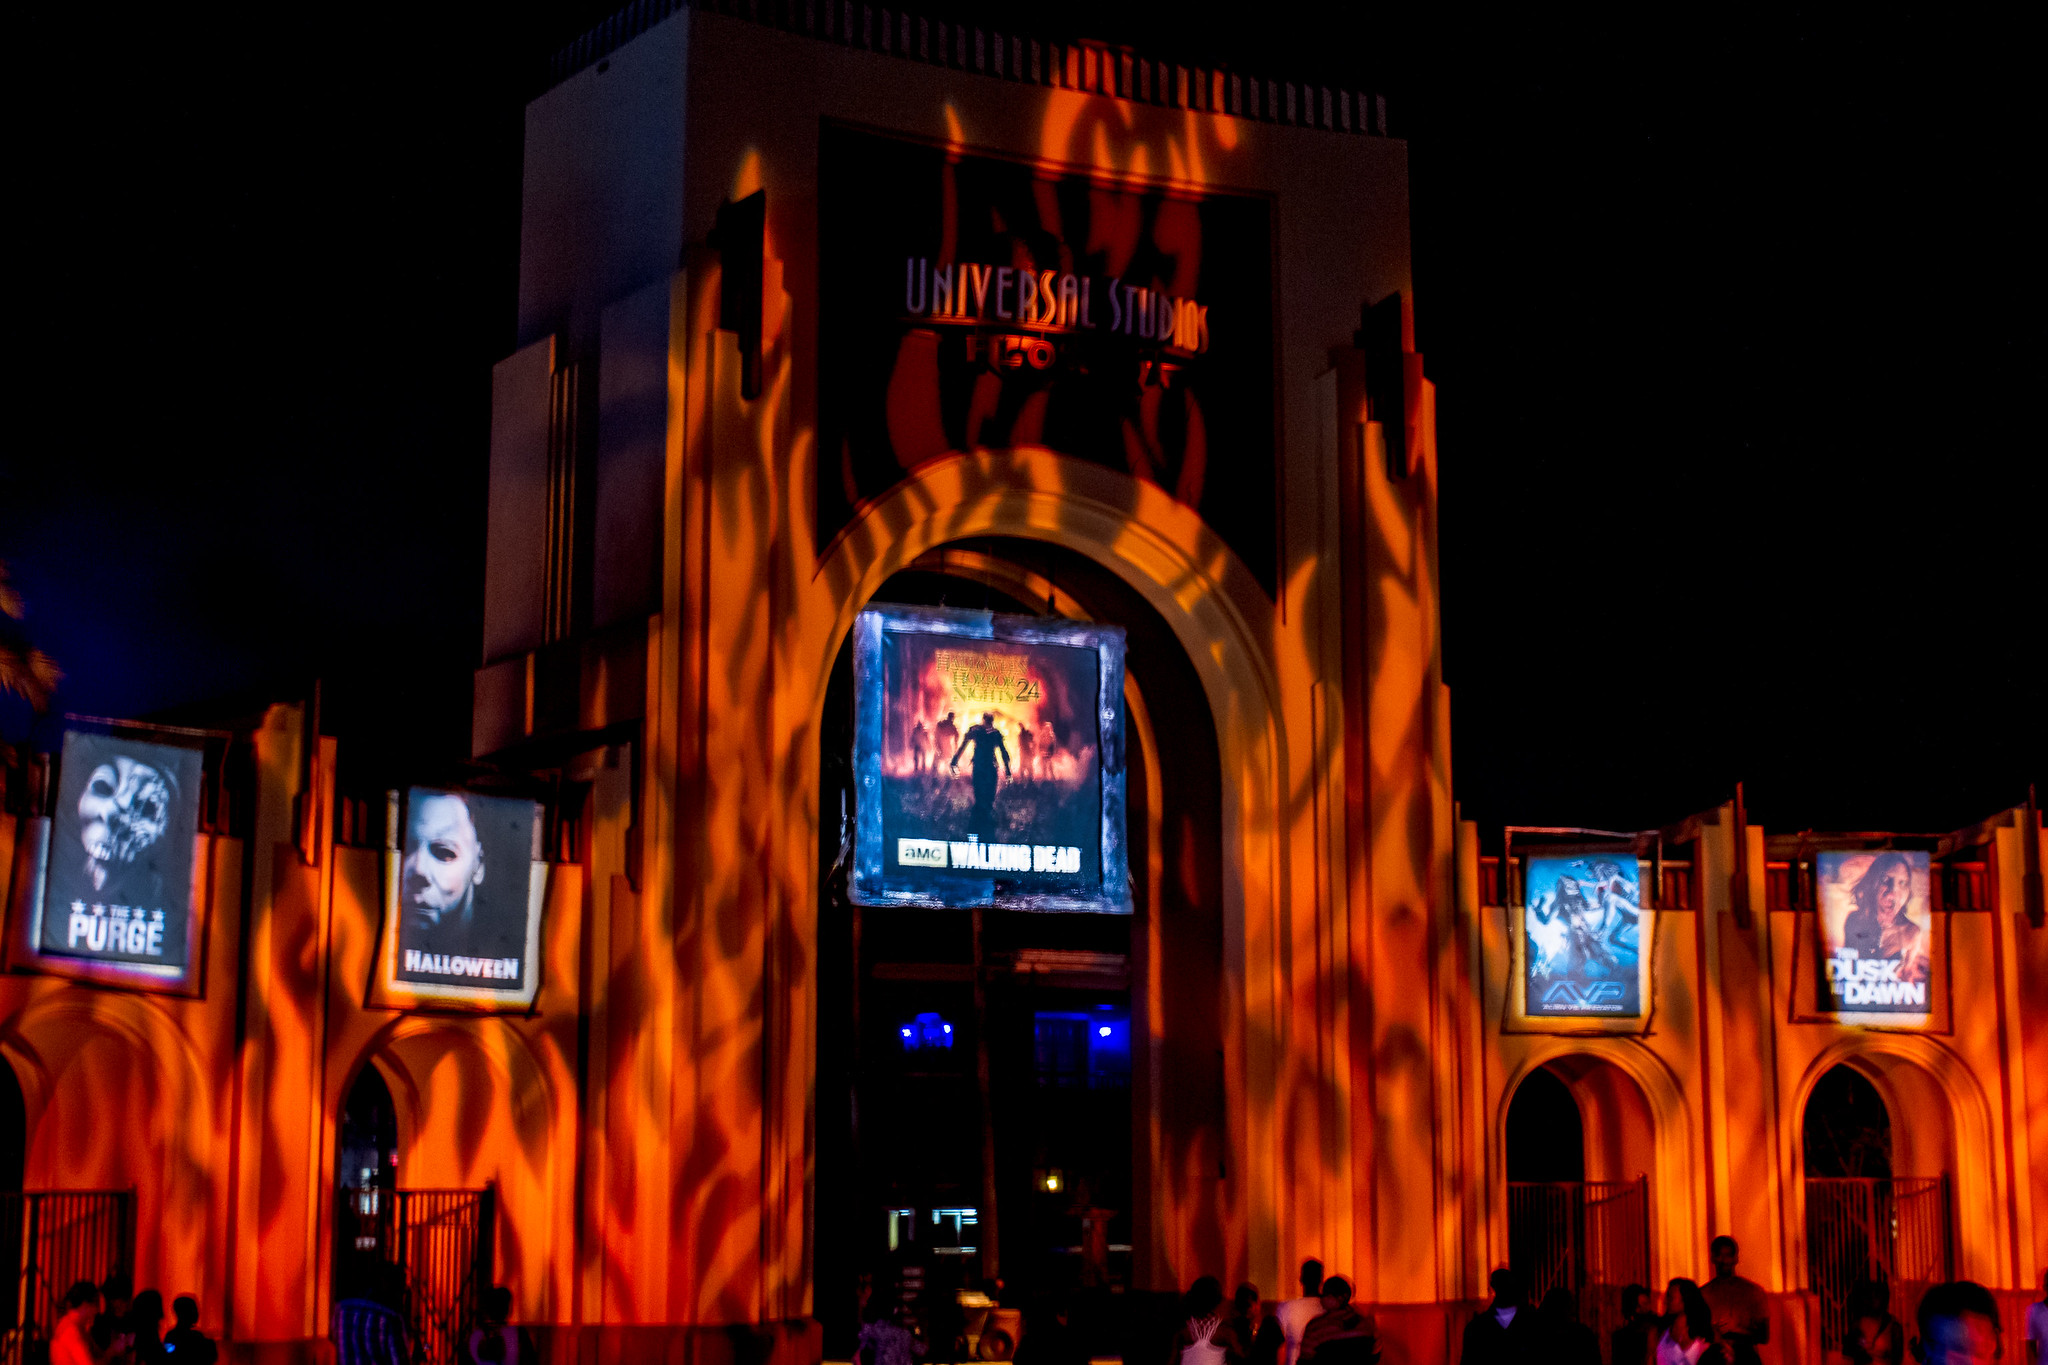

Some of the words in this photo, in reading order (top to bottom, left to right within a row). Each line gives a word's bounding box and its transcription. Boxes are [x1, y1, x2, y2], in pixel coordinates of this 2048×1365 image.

[906, 257, 1096, 327] UNIVERSAL
[1109, 278, 1209, 354] STUDIOS
[1016, 678, 1040, 702] 24
[1033, 845, 1081, 873] DEAD
[68, 913, 164, 956] PURGE
[405, 949, 518, 979] HALLOWEEN
[1827, 958, 1901, 982] DUSK
[1843, 981, 1925, 1005] DAWN
